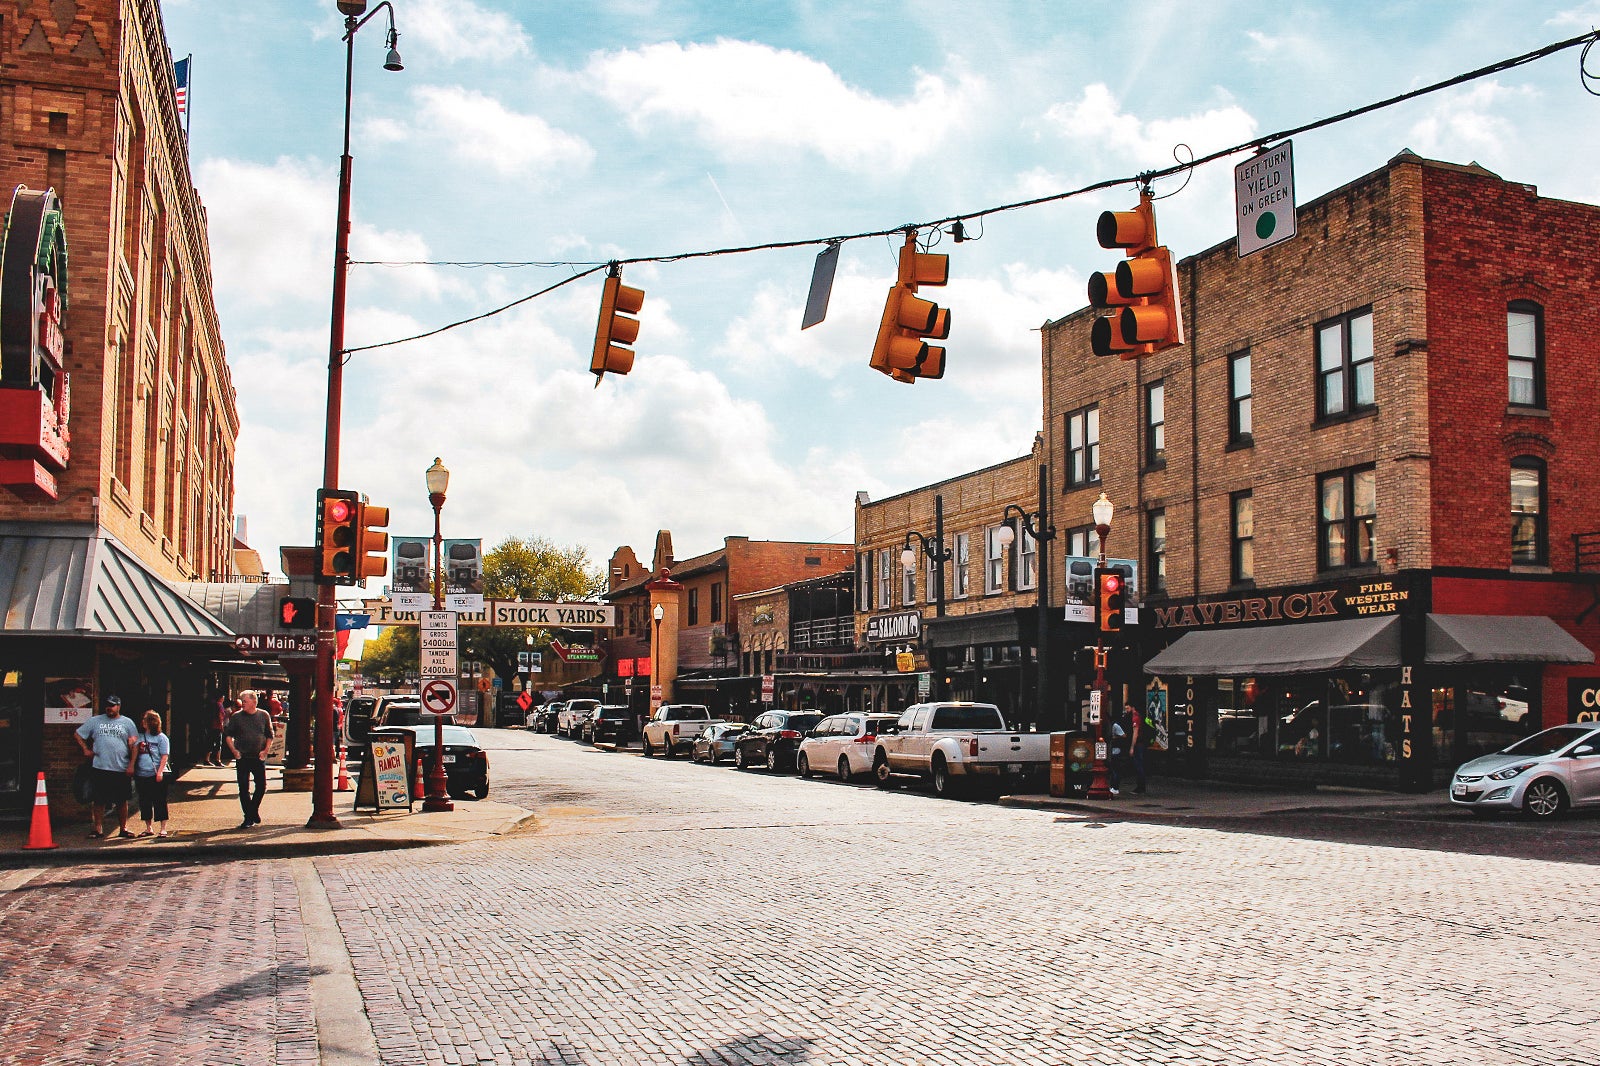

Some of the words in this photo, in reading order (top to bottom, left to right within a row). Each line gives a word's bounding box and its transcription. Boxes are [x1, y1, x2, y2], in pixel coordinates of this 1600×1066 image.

[1240, 163, 1260, 181] LEFT
[1263, 151, 1286, 169] TURN
[1248, 170, 1281, 196] YIELD
[1242, 201, 1254, 216] ON
[1258, 187, 1288, 209] GREEN
[1344, 590, 1409, 606] WESTERN
[1360, 582, 1393, 594] FINE
[380, 606, 420, 621] FOR
[498, 608, 549, 622] STOCK
[556, 609, 606, 623] YARDS
[1154, 590, 1339, 629] MAVERICK
[1357, 602, 1396, 615] WEAR
[879, 615, 909, 638] SALOON
[251, 636, 259, 649] N
[266, 636, 295, 649] Main
[1186, 675, 1194, 748] BOOTS
[1401, 666, 1412, 759] HATS
[99, 723, 123, 731] DALLAS
[378, 755, 401, 772] RANCH
